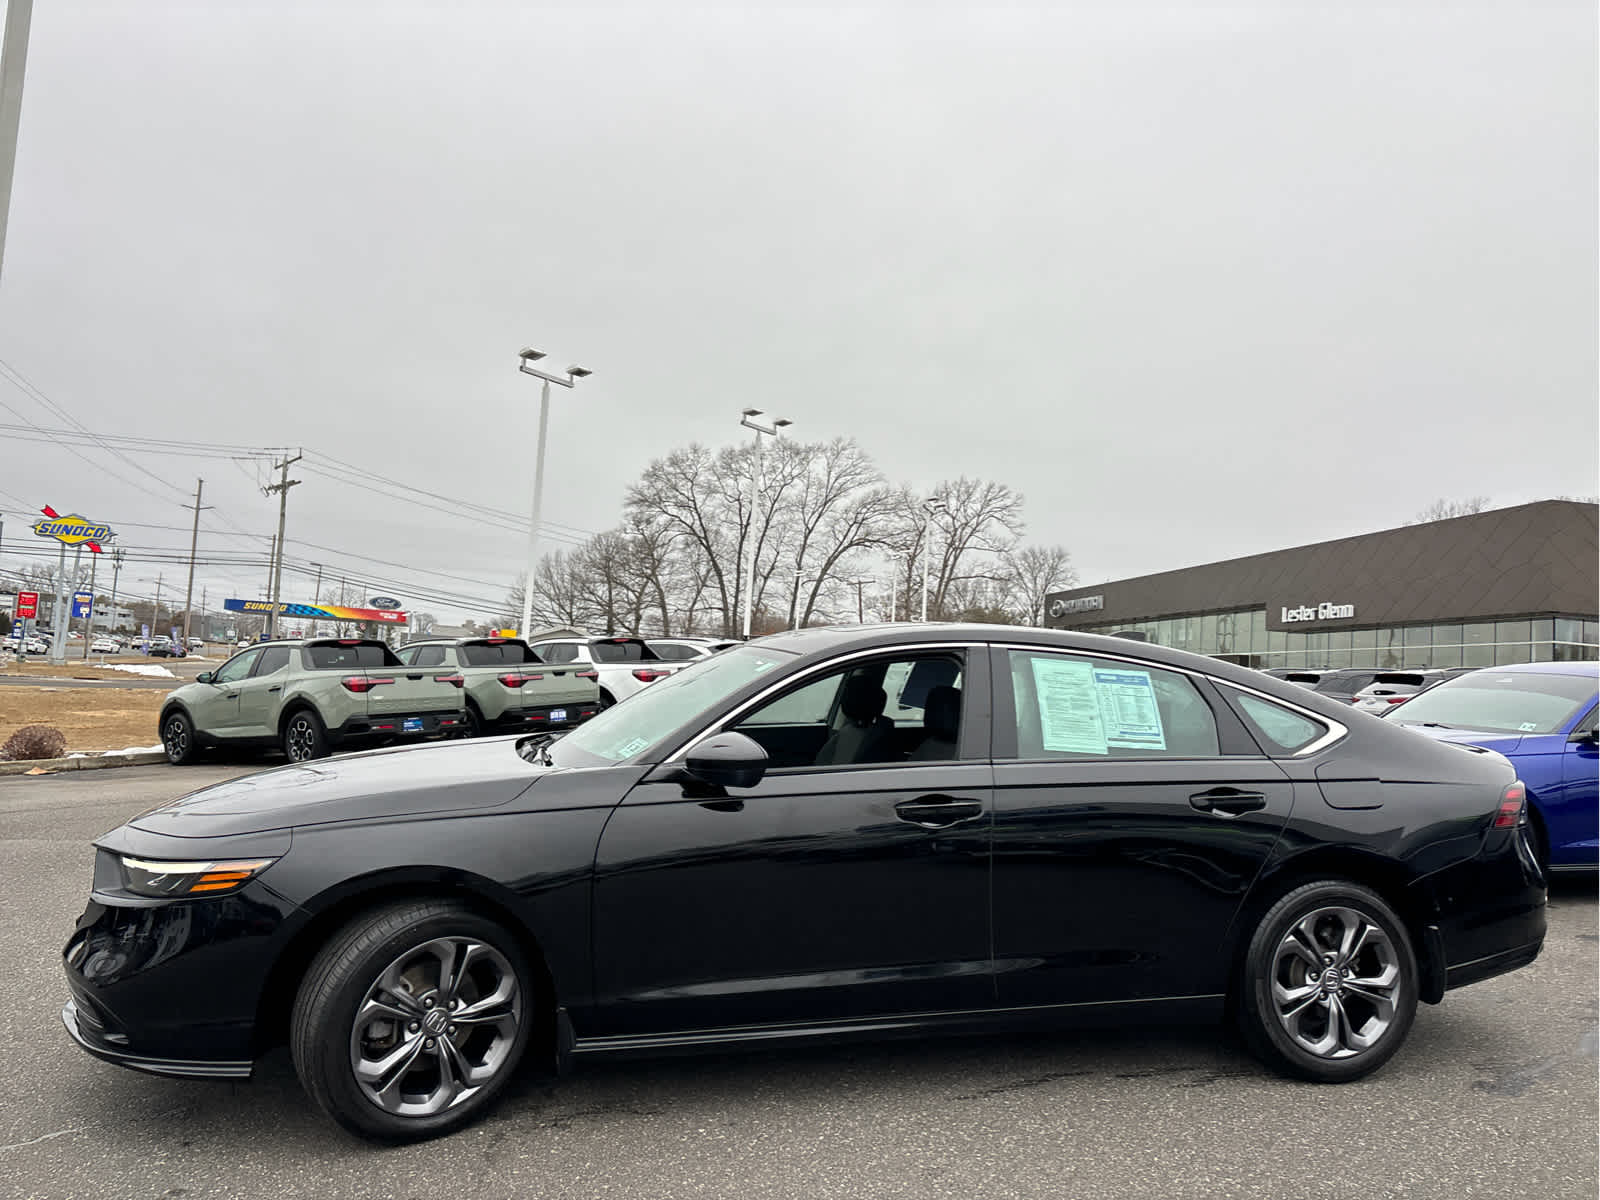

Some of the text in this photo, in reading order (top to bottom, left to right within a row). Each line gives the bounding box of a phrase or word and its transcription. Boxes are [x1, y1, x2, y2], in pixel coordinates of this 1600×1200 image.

[38, 522, 107, 538] SUNOCO
[243, 601, 288, 612] SUNOO
[1281, 602, 1354, 623] Lester Glenn
